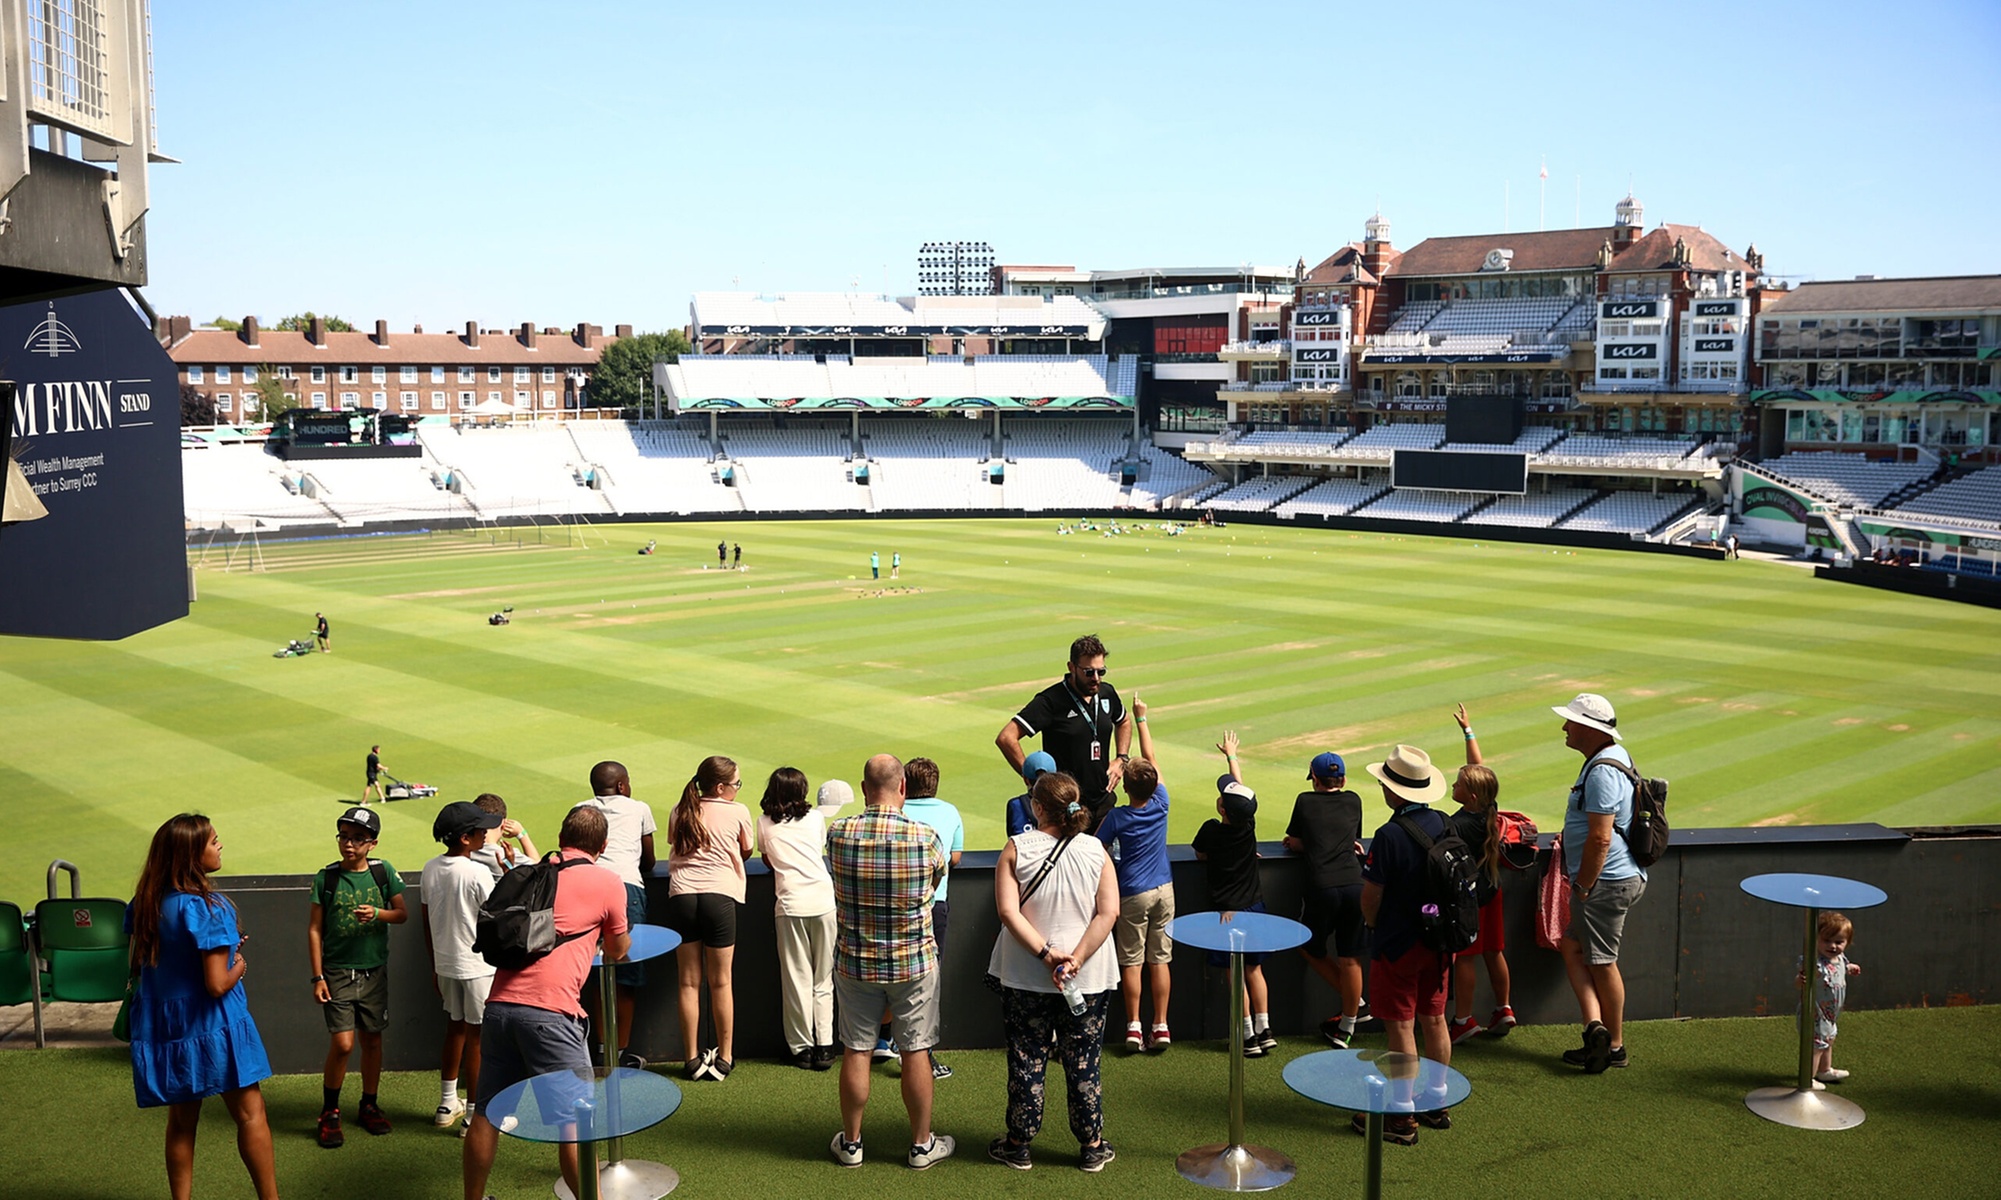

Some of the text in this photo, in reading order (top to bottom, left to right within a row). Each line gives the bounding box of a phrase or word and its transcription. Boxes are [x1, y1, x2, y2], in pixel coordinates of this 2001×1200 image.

[43, 380, 112, 434] FINN
[120, 393, 150, 413] STAND
[1400, 403, 1412, 411] THE
[1413, 403, 1434, 411] MICKY
[299, 424, 348, 435] HUNDRED
[37, 457, 61, 474] Wealth
[62, 452, 104, 471] Management
[51, 479, 59, 492] to
[60, 477, 82, 491] Surrey
